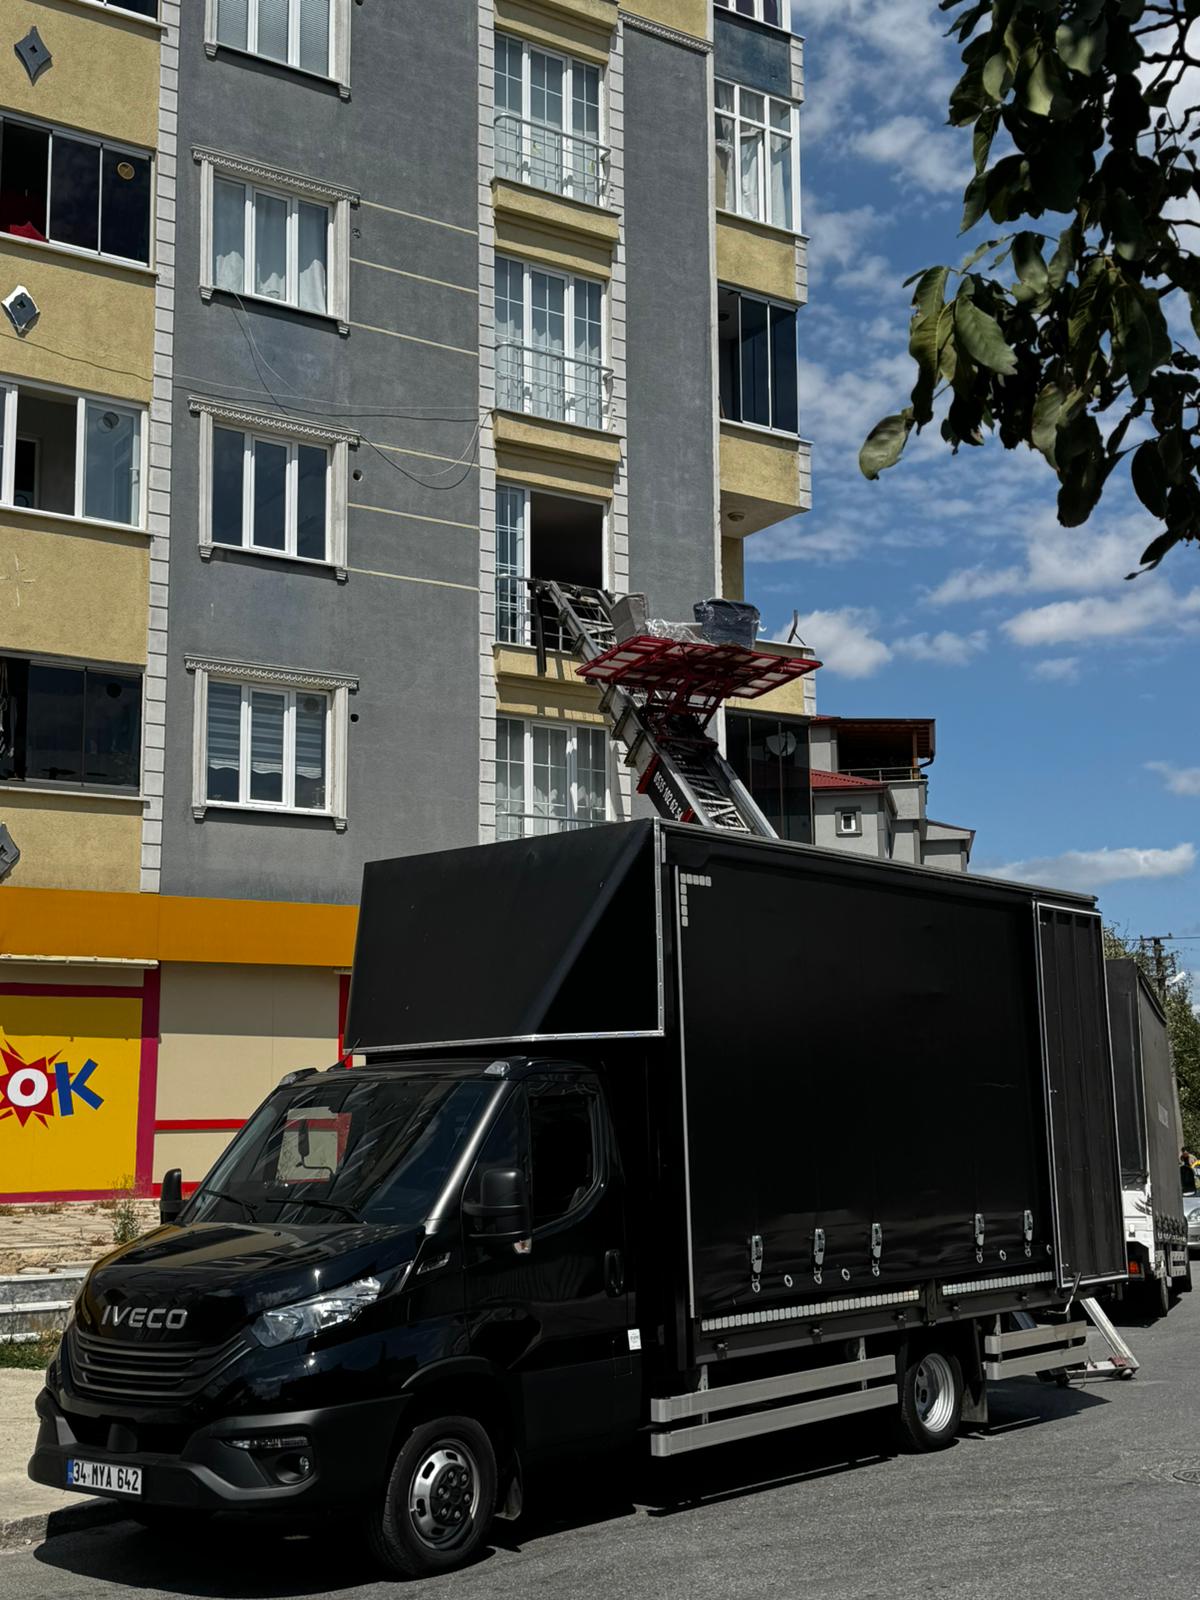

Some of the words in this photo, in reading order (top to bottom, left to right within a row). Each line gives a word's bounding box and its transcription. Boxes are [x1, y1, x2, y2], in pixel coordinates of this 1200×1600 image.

[669, 798, 679, 814] 62
[6, 1058, 105, 1117] OK
[101, 1305, 189, 1330] IVECO
[73, 1462, 87, 1484] 34
[91, 1463, 113, 1488] MYA
[117, 1468, 139, 1492] 642
